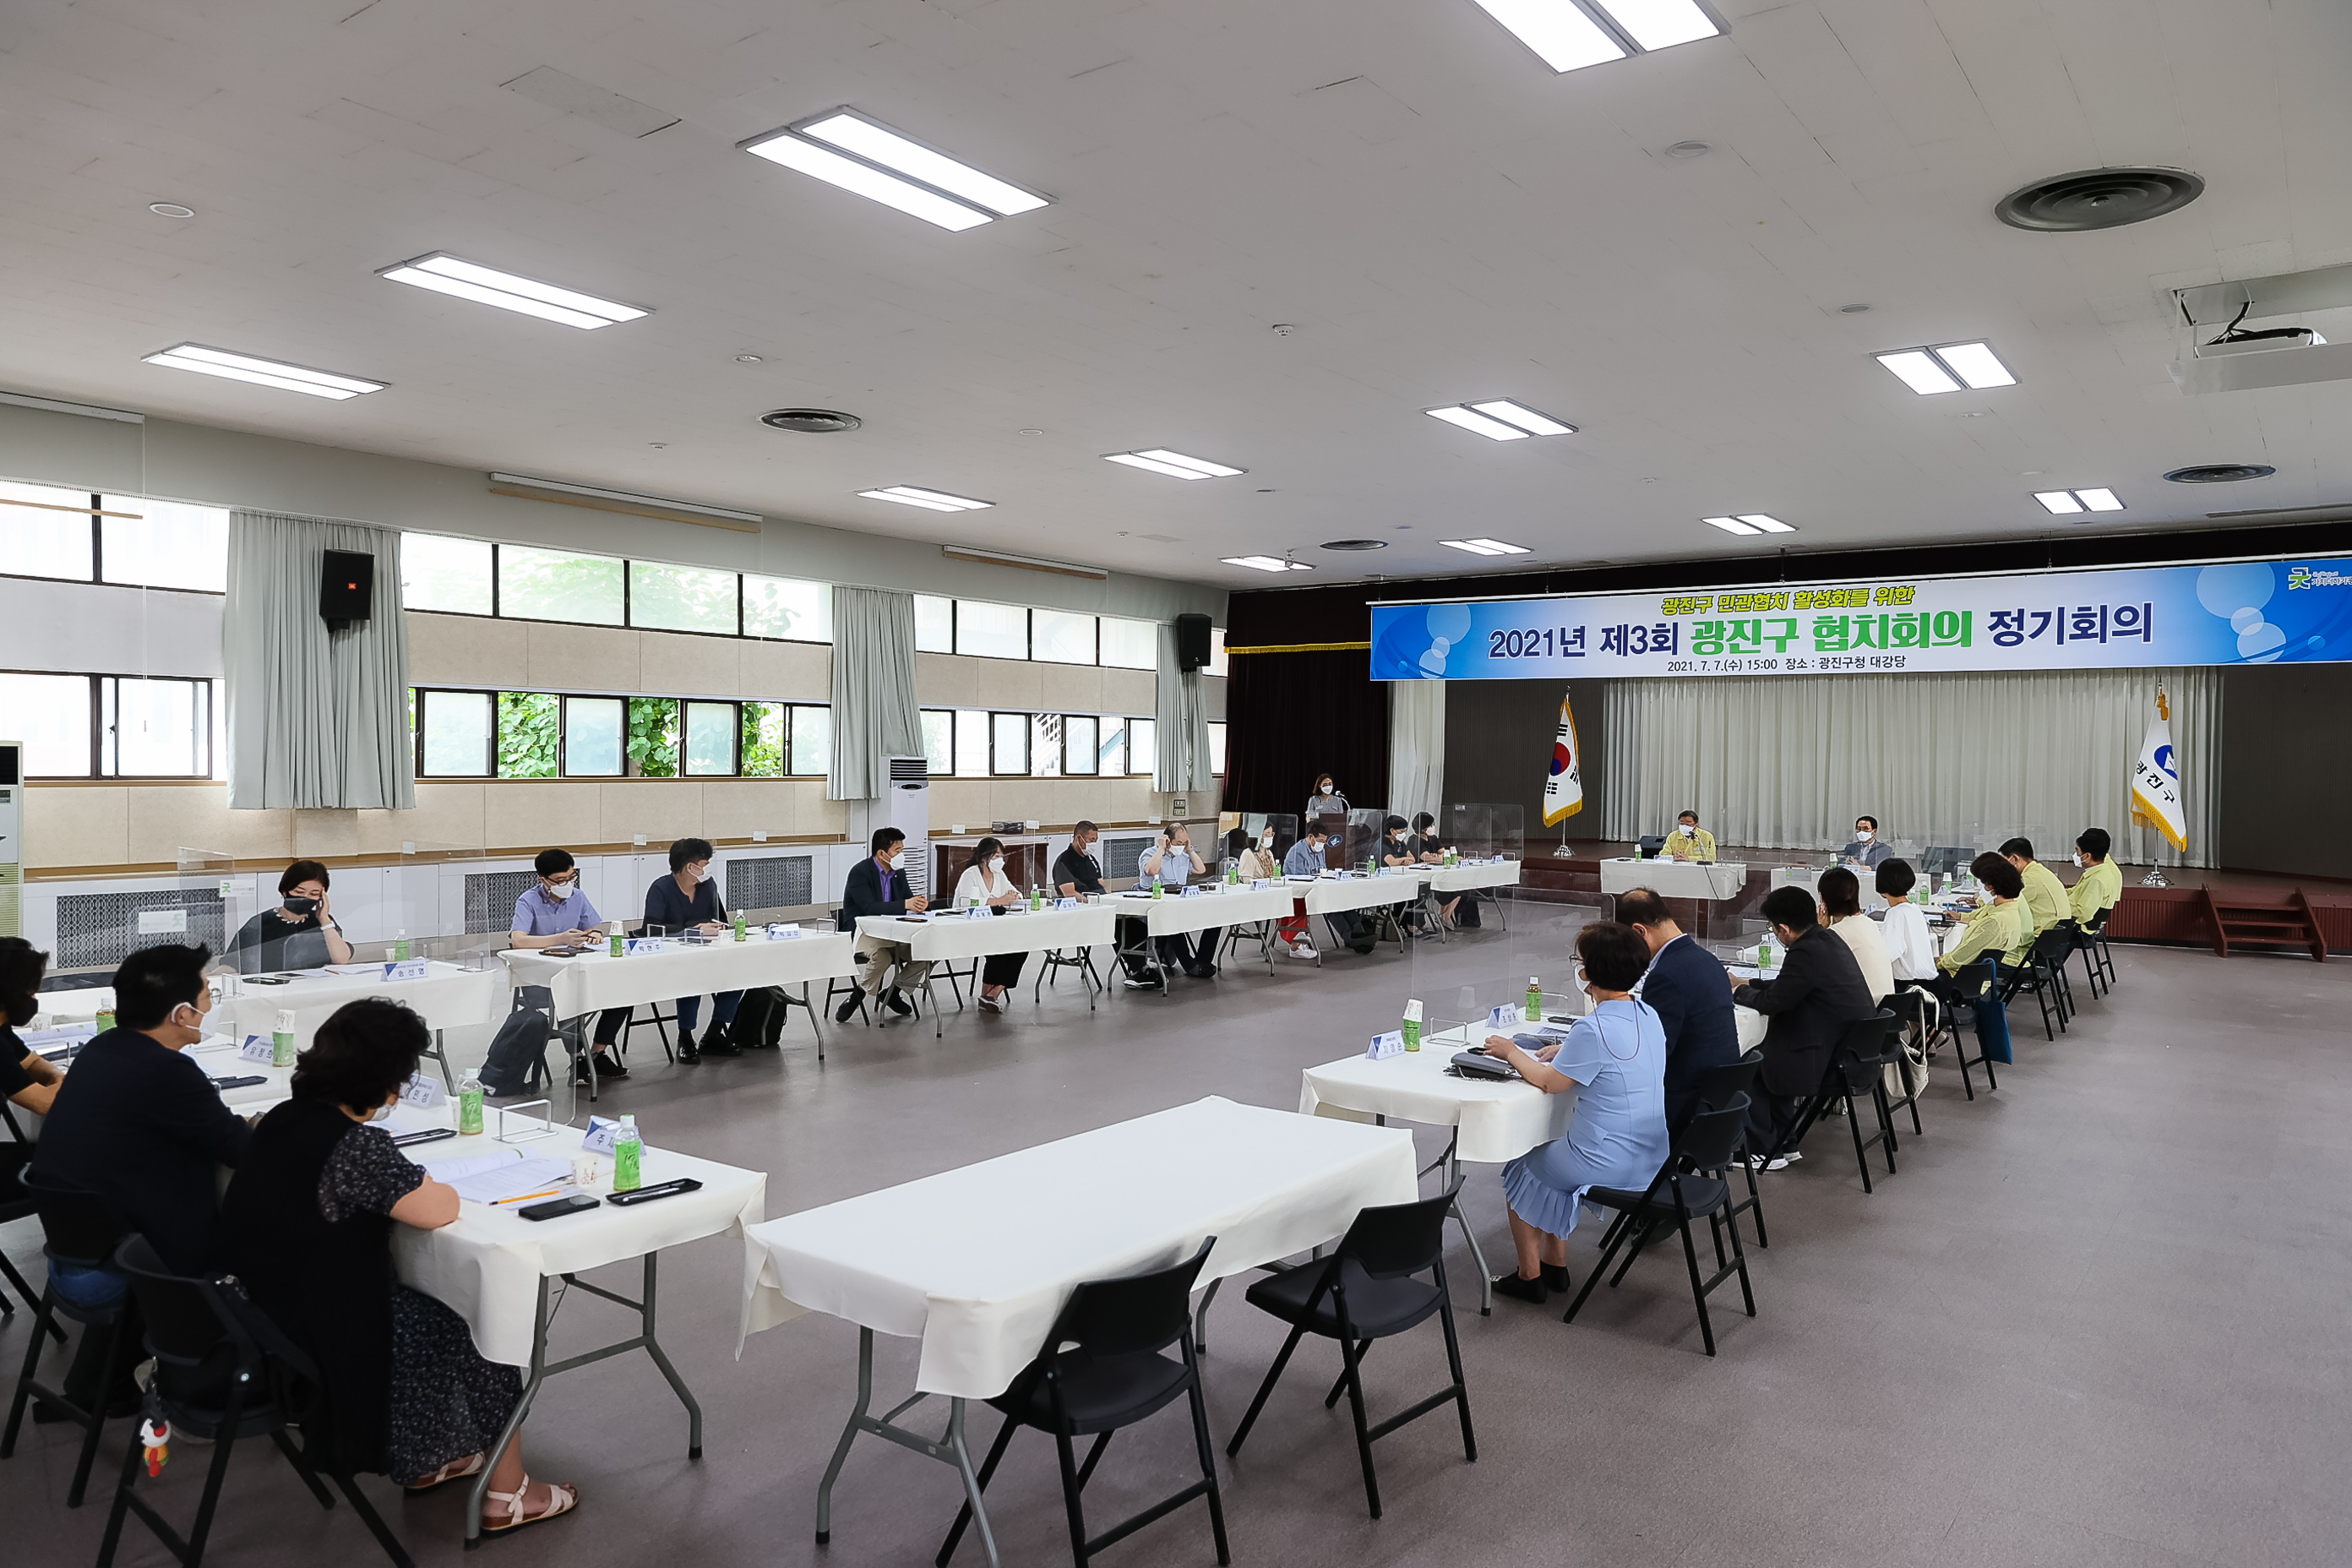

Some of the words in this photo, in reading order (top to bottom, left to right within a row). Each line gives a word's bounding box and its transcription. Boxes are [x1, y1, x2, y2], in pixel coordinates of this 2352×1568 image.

[1661, 596, 1713, 615] 광진구
[1718, 591, 1789, 612] 민관협치
[1793, 587, 1871, 610] 활성화를
[1874, 585, 1916, 606] 위한
[1488, 626, 1587, 658] 2021년
[1600, 622, 1679, 656] 제3회
[1690, 618, 1799, 655] 광진구
[1811, 611, 1972, 651] 협치회의
[1988, 602, 2153, 646] 정기회의
[1667, 661, 1697, 672] 2021.
[1701, 661, 1711, 672] 7.
[1747, 659, 1778, 670] 15:00
[1785, 658, 1807, 670] 장소
[1818, 656, 1865, 669] 광진구청
[1870, 655, 1907, 668] 대강당
[2136, 760, 2175, 803] 광진구
